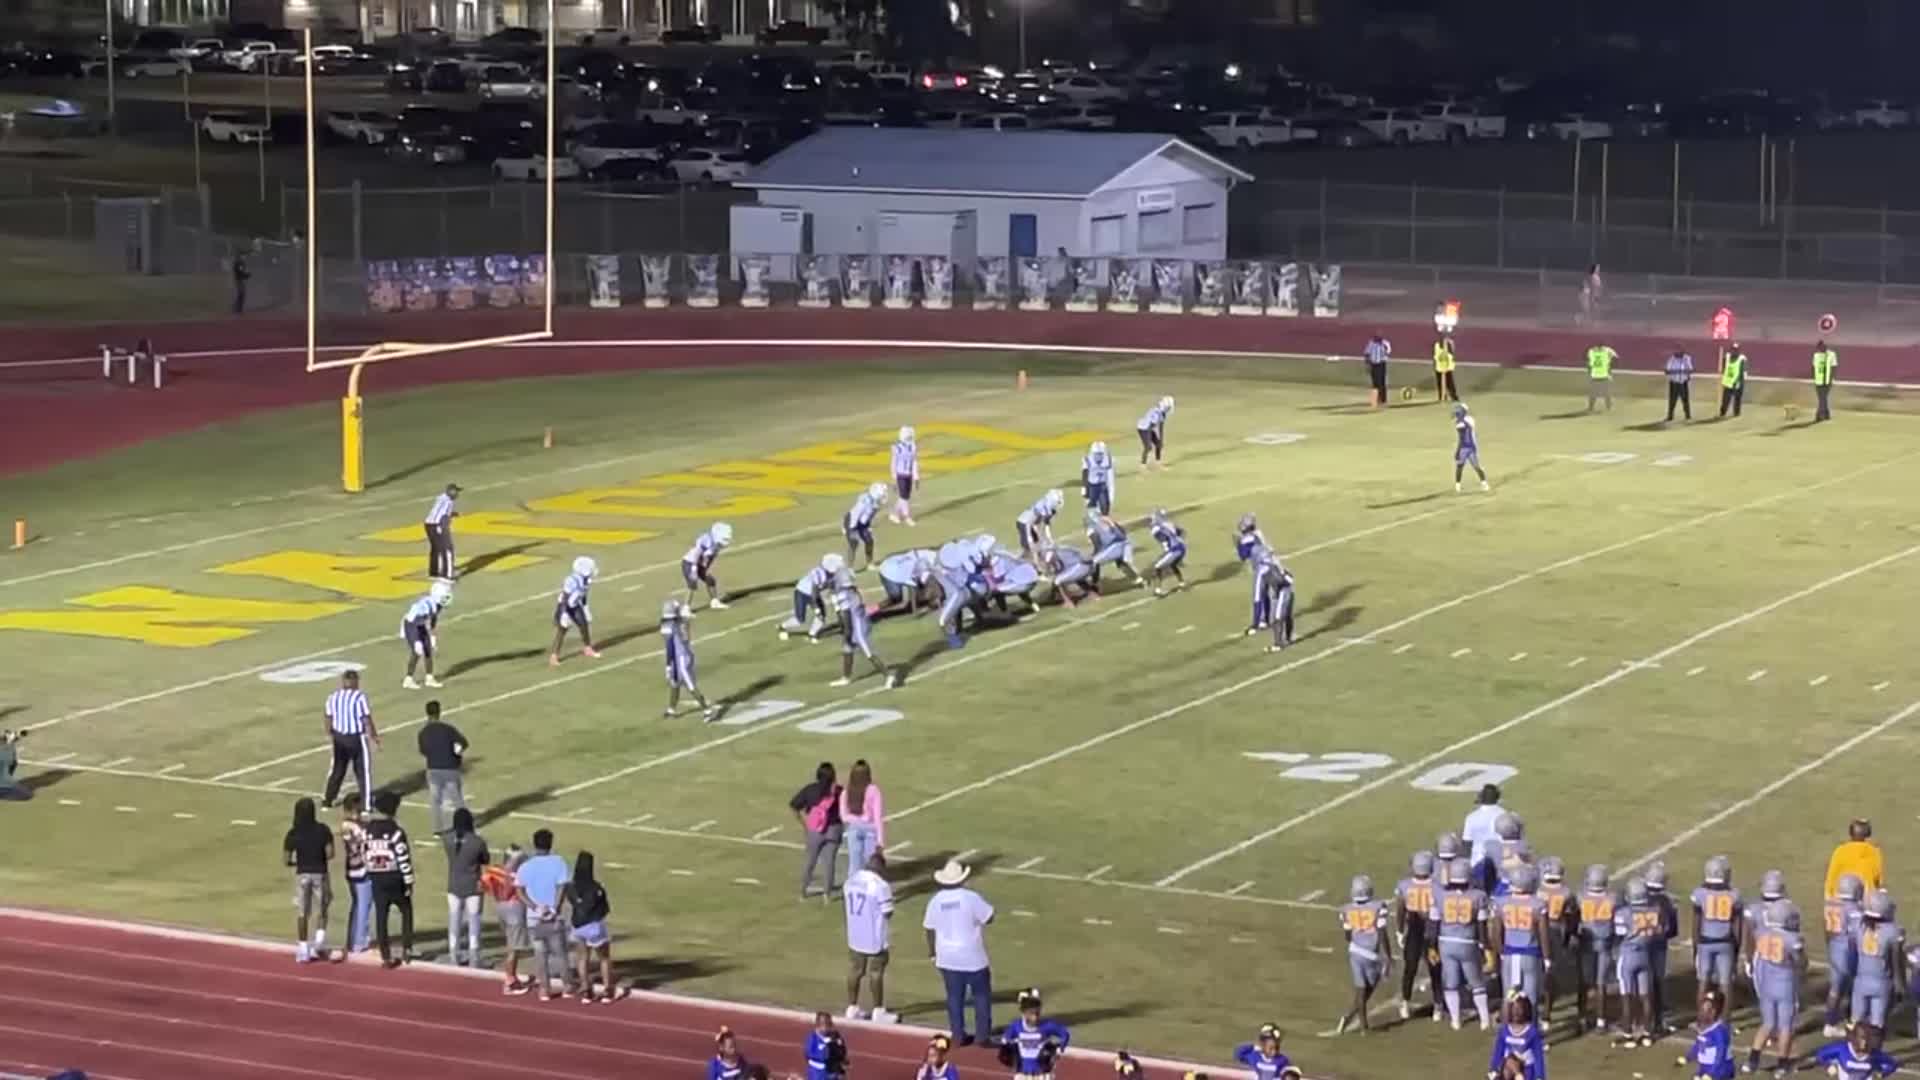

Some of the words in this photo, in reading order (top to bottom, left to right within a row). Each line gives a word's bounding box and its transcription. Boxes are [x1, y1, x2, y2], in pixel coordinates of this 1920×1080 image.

[0, 422, 1118, 647] NATCHEZ
[1278, 752, 1519, 792] 20
[848, 892, 867, 916] 17
